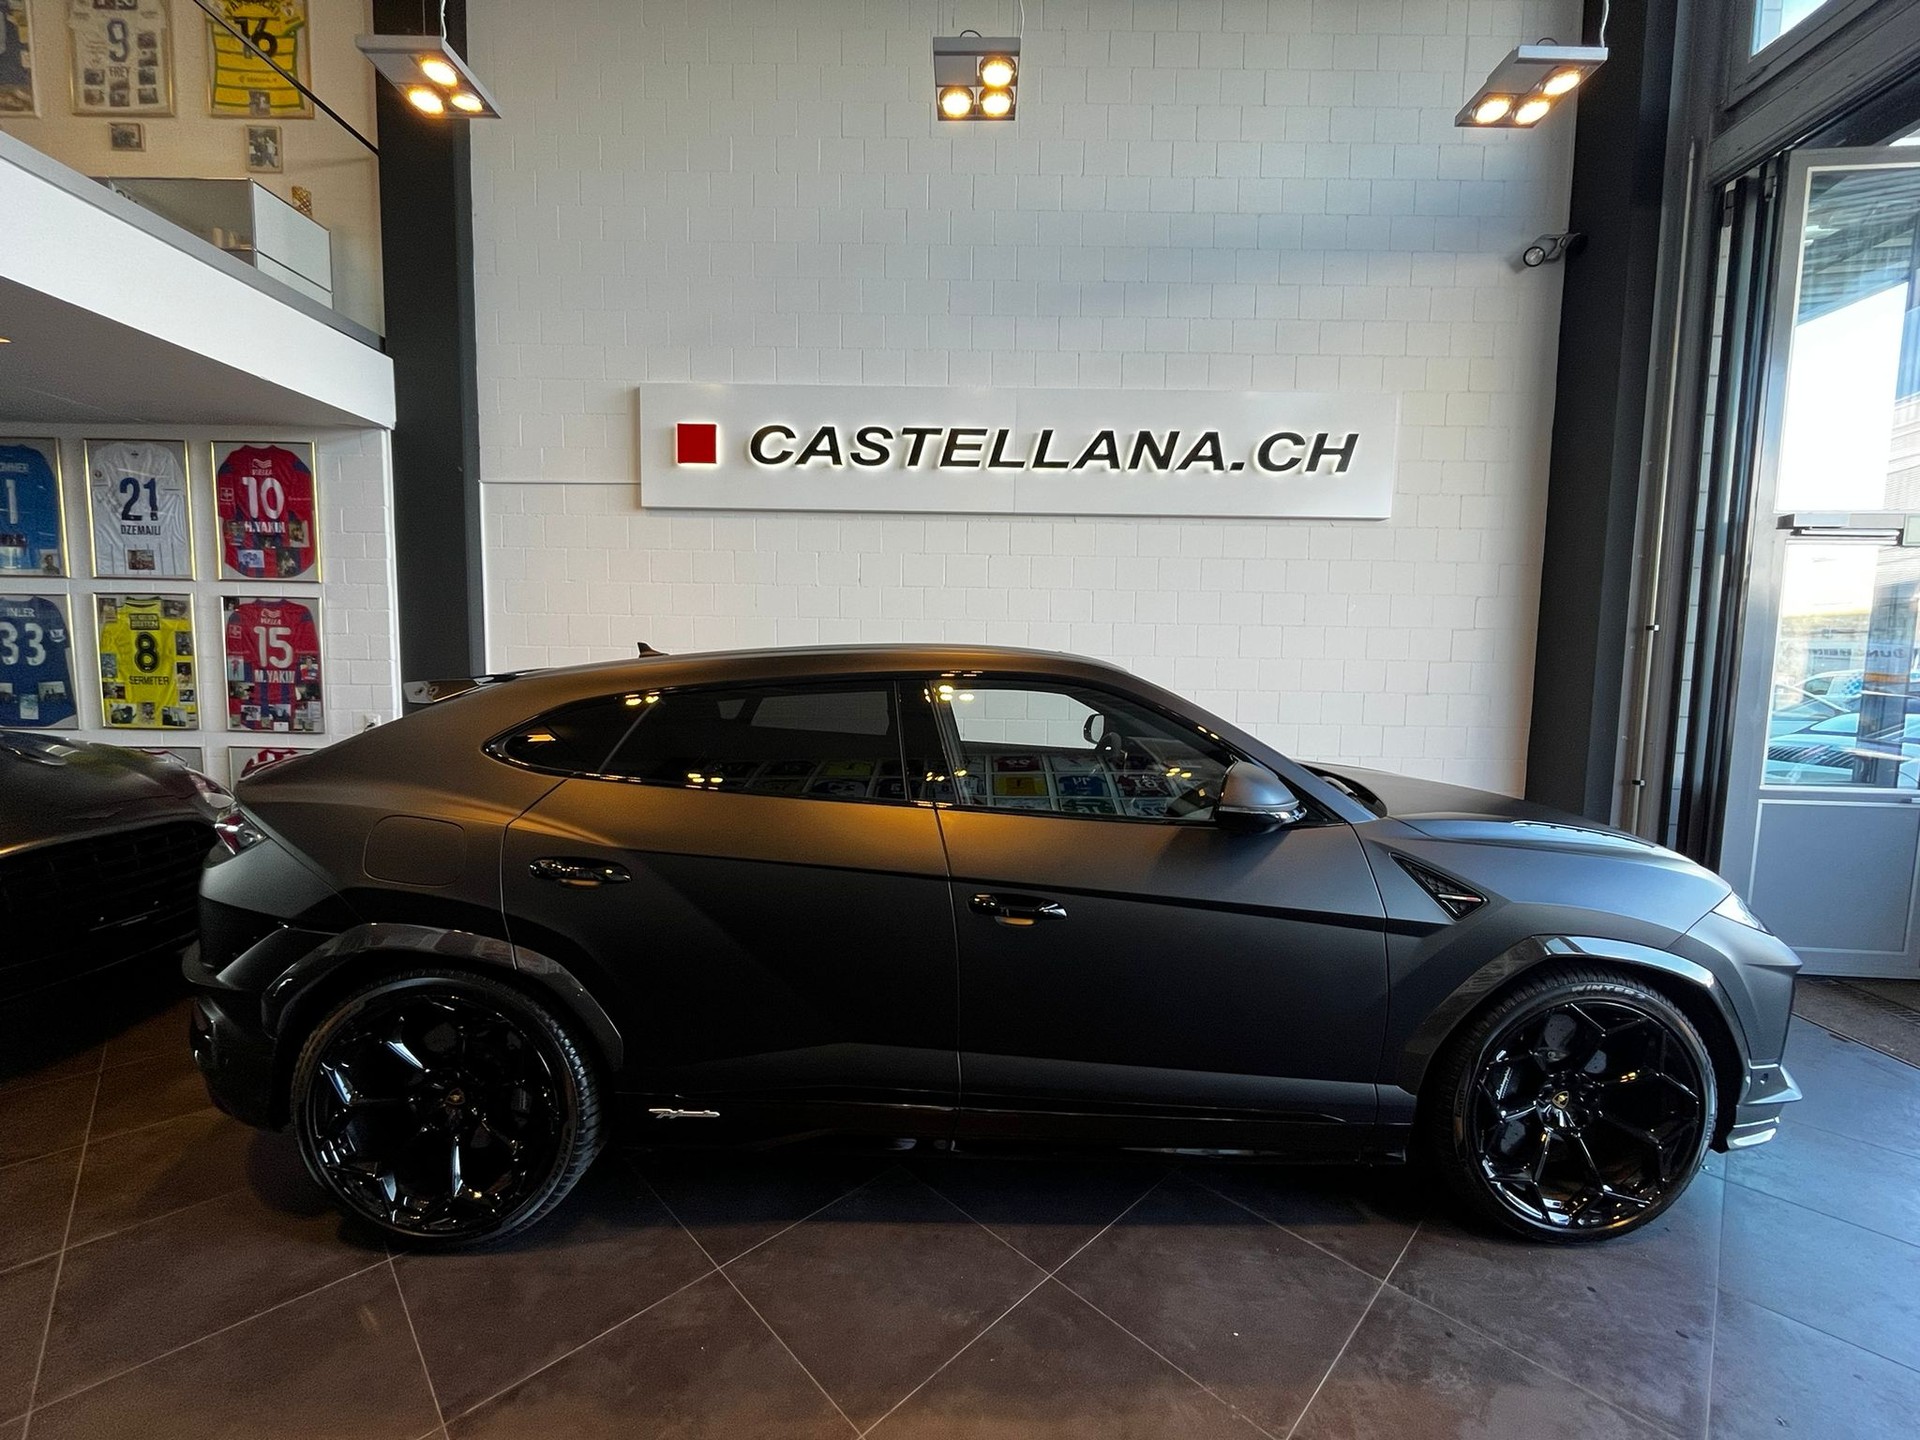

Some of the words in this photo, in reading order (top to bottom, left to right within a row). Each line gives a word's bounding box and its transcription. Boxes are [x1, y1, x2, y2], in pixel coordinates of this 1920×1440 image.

[107, 17, 129, 63] 9
[234, 17, 278, 59] 16
[748, 423, 1360, 474] CASTELLANA.CH
[119, 477, 158, 521] 21
[242, 476, 285, 520] 10
[120, 524, 161, 536] DZEMAILI
[0, 621, 46, 667] 33
[134, 631, 161, 674] 8
[253, 626, 294, 669] 15
[254, 669, 297, 684] M.YAKIN
